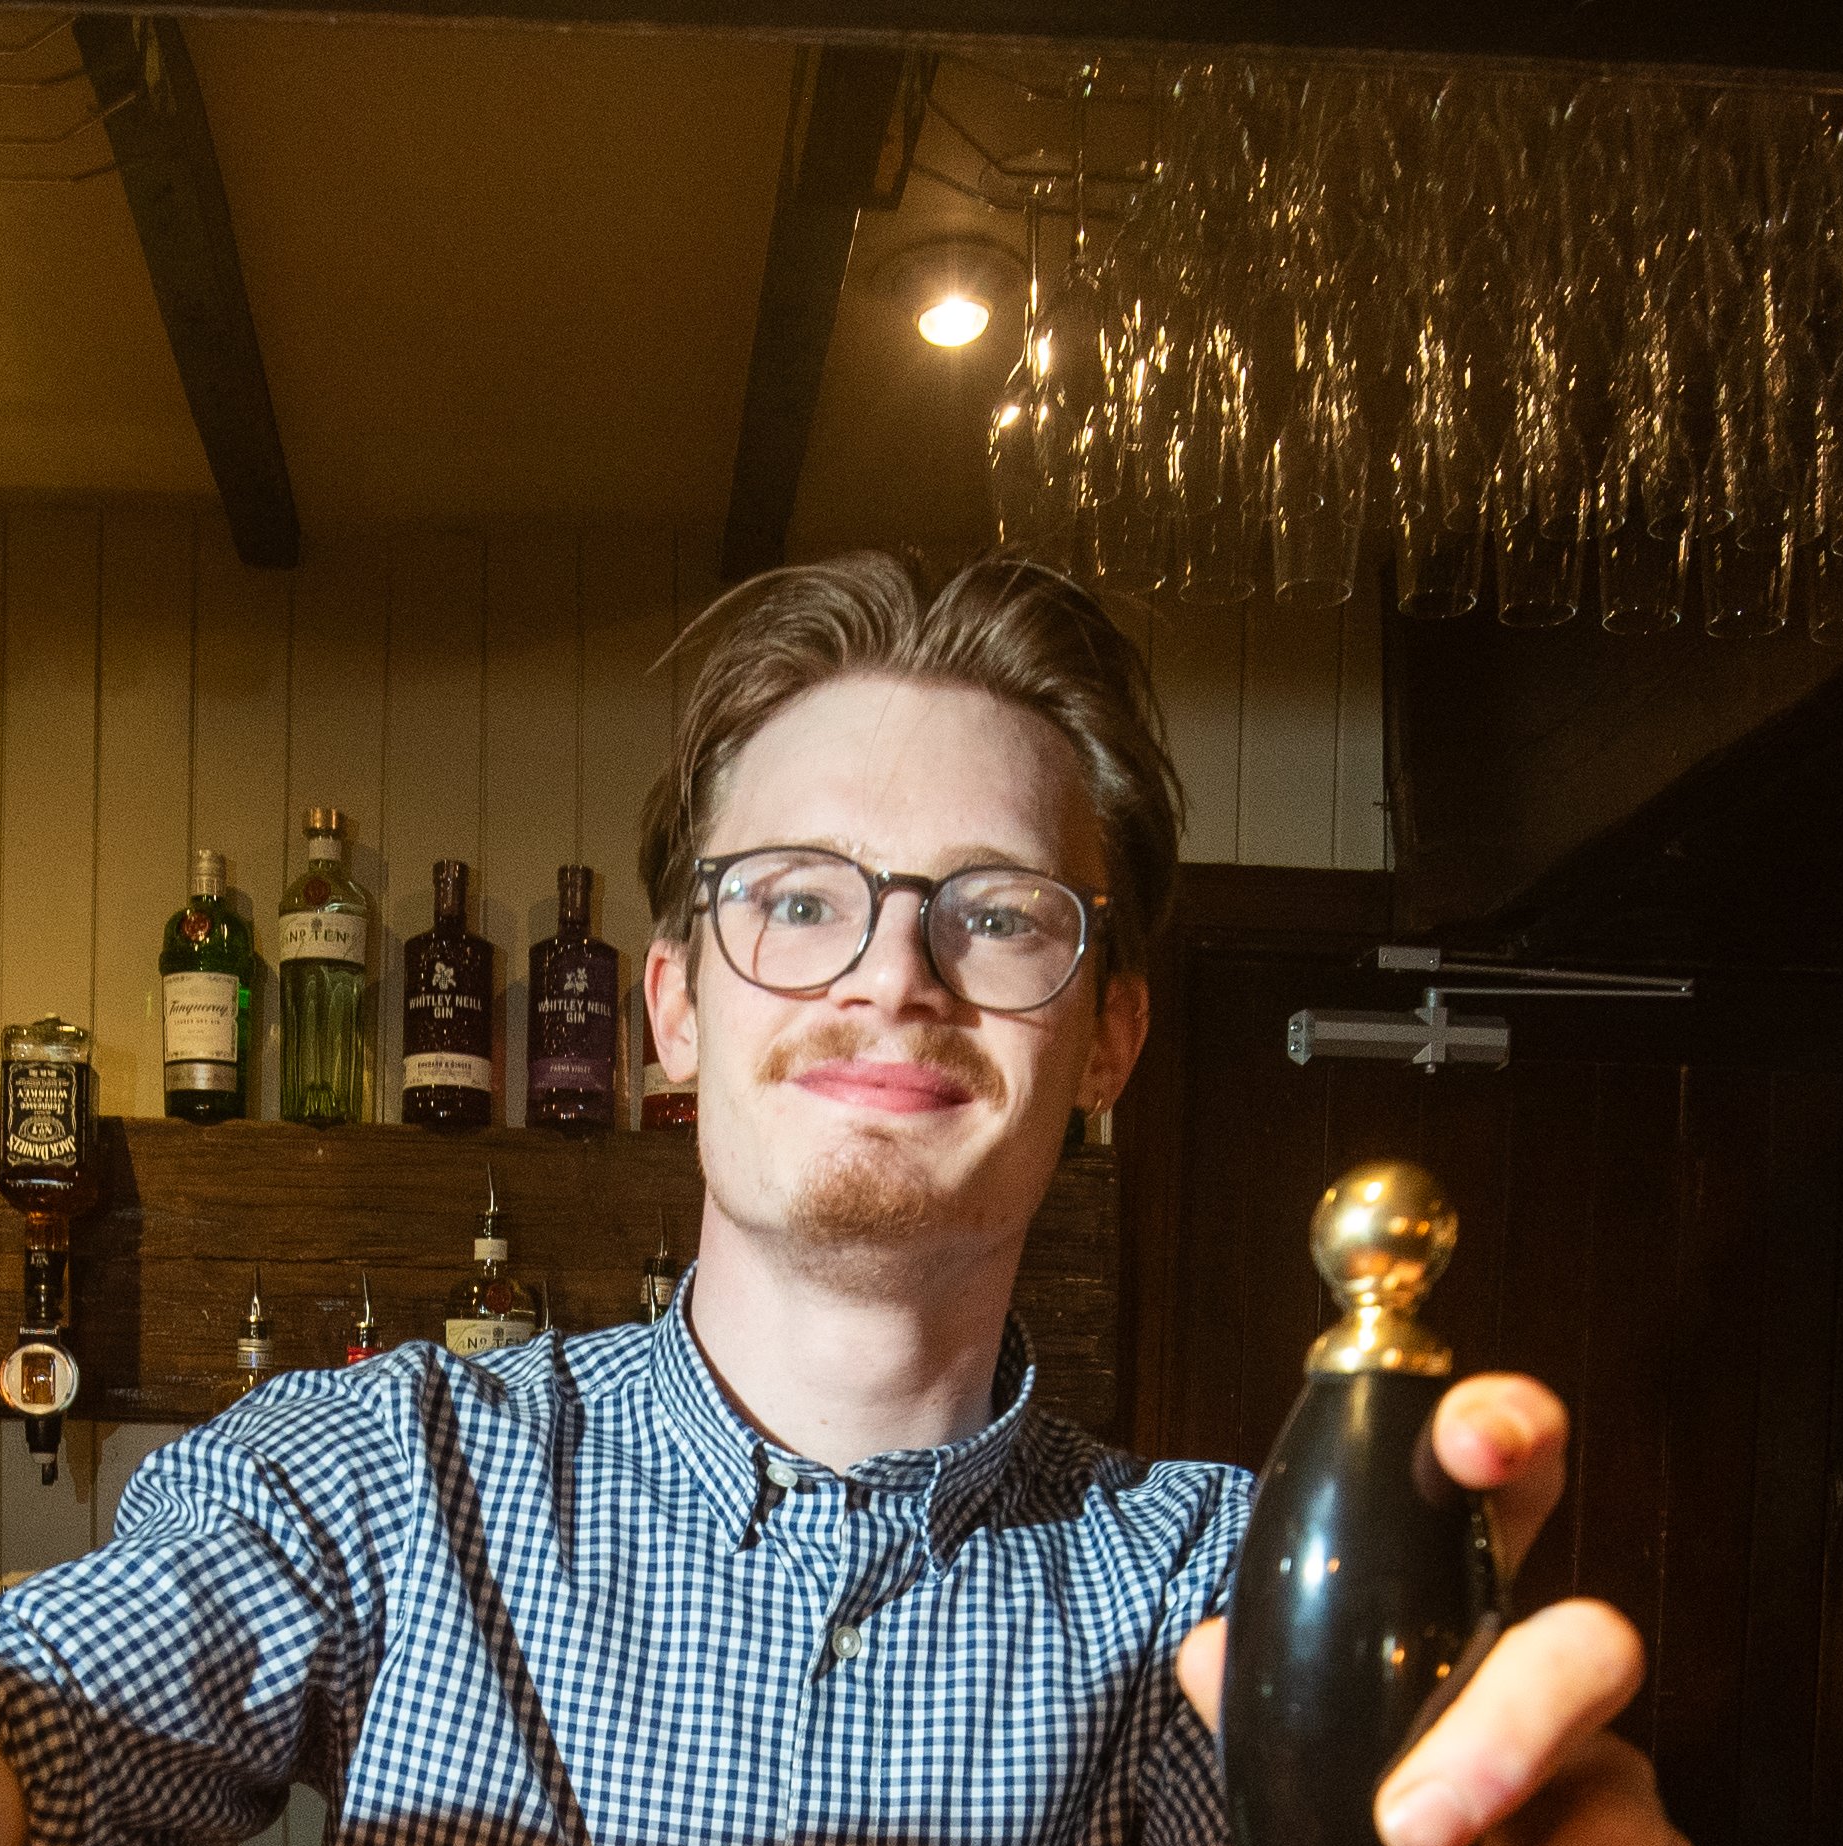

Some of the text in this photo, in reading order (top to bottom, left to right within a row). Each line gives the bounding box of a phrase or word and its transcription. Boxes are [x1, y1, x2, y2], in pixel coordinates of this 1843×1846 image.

[313, 930, 348, 944] TEN
[168, 999, 229, 1016] Tanqueray
[408, 994, 483, 1012] WHITLEY NEILL
[537, 997, 612, 1018] WHITLEY NEILL
[433, 1006, 454, 1020] GIN
[565, 1010, 586, 1024] GIN
[16, 1087, 69, 1100] WHISKEY
[6, 1134, 77, 1161] JACK DANIEL'S
